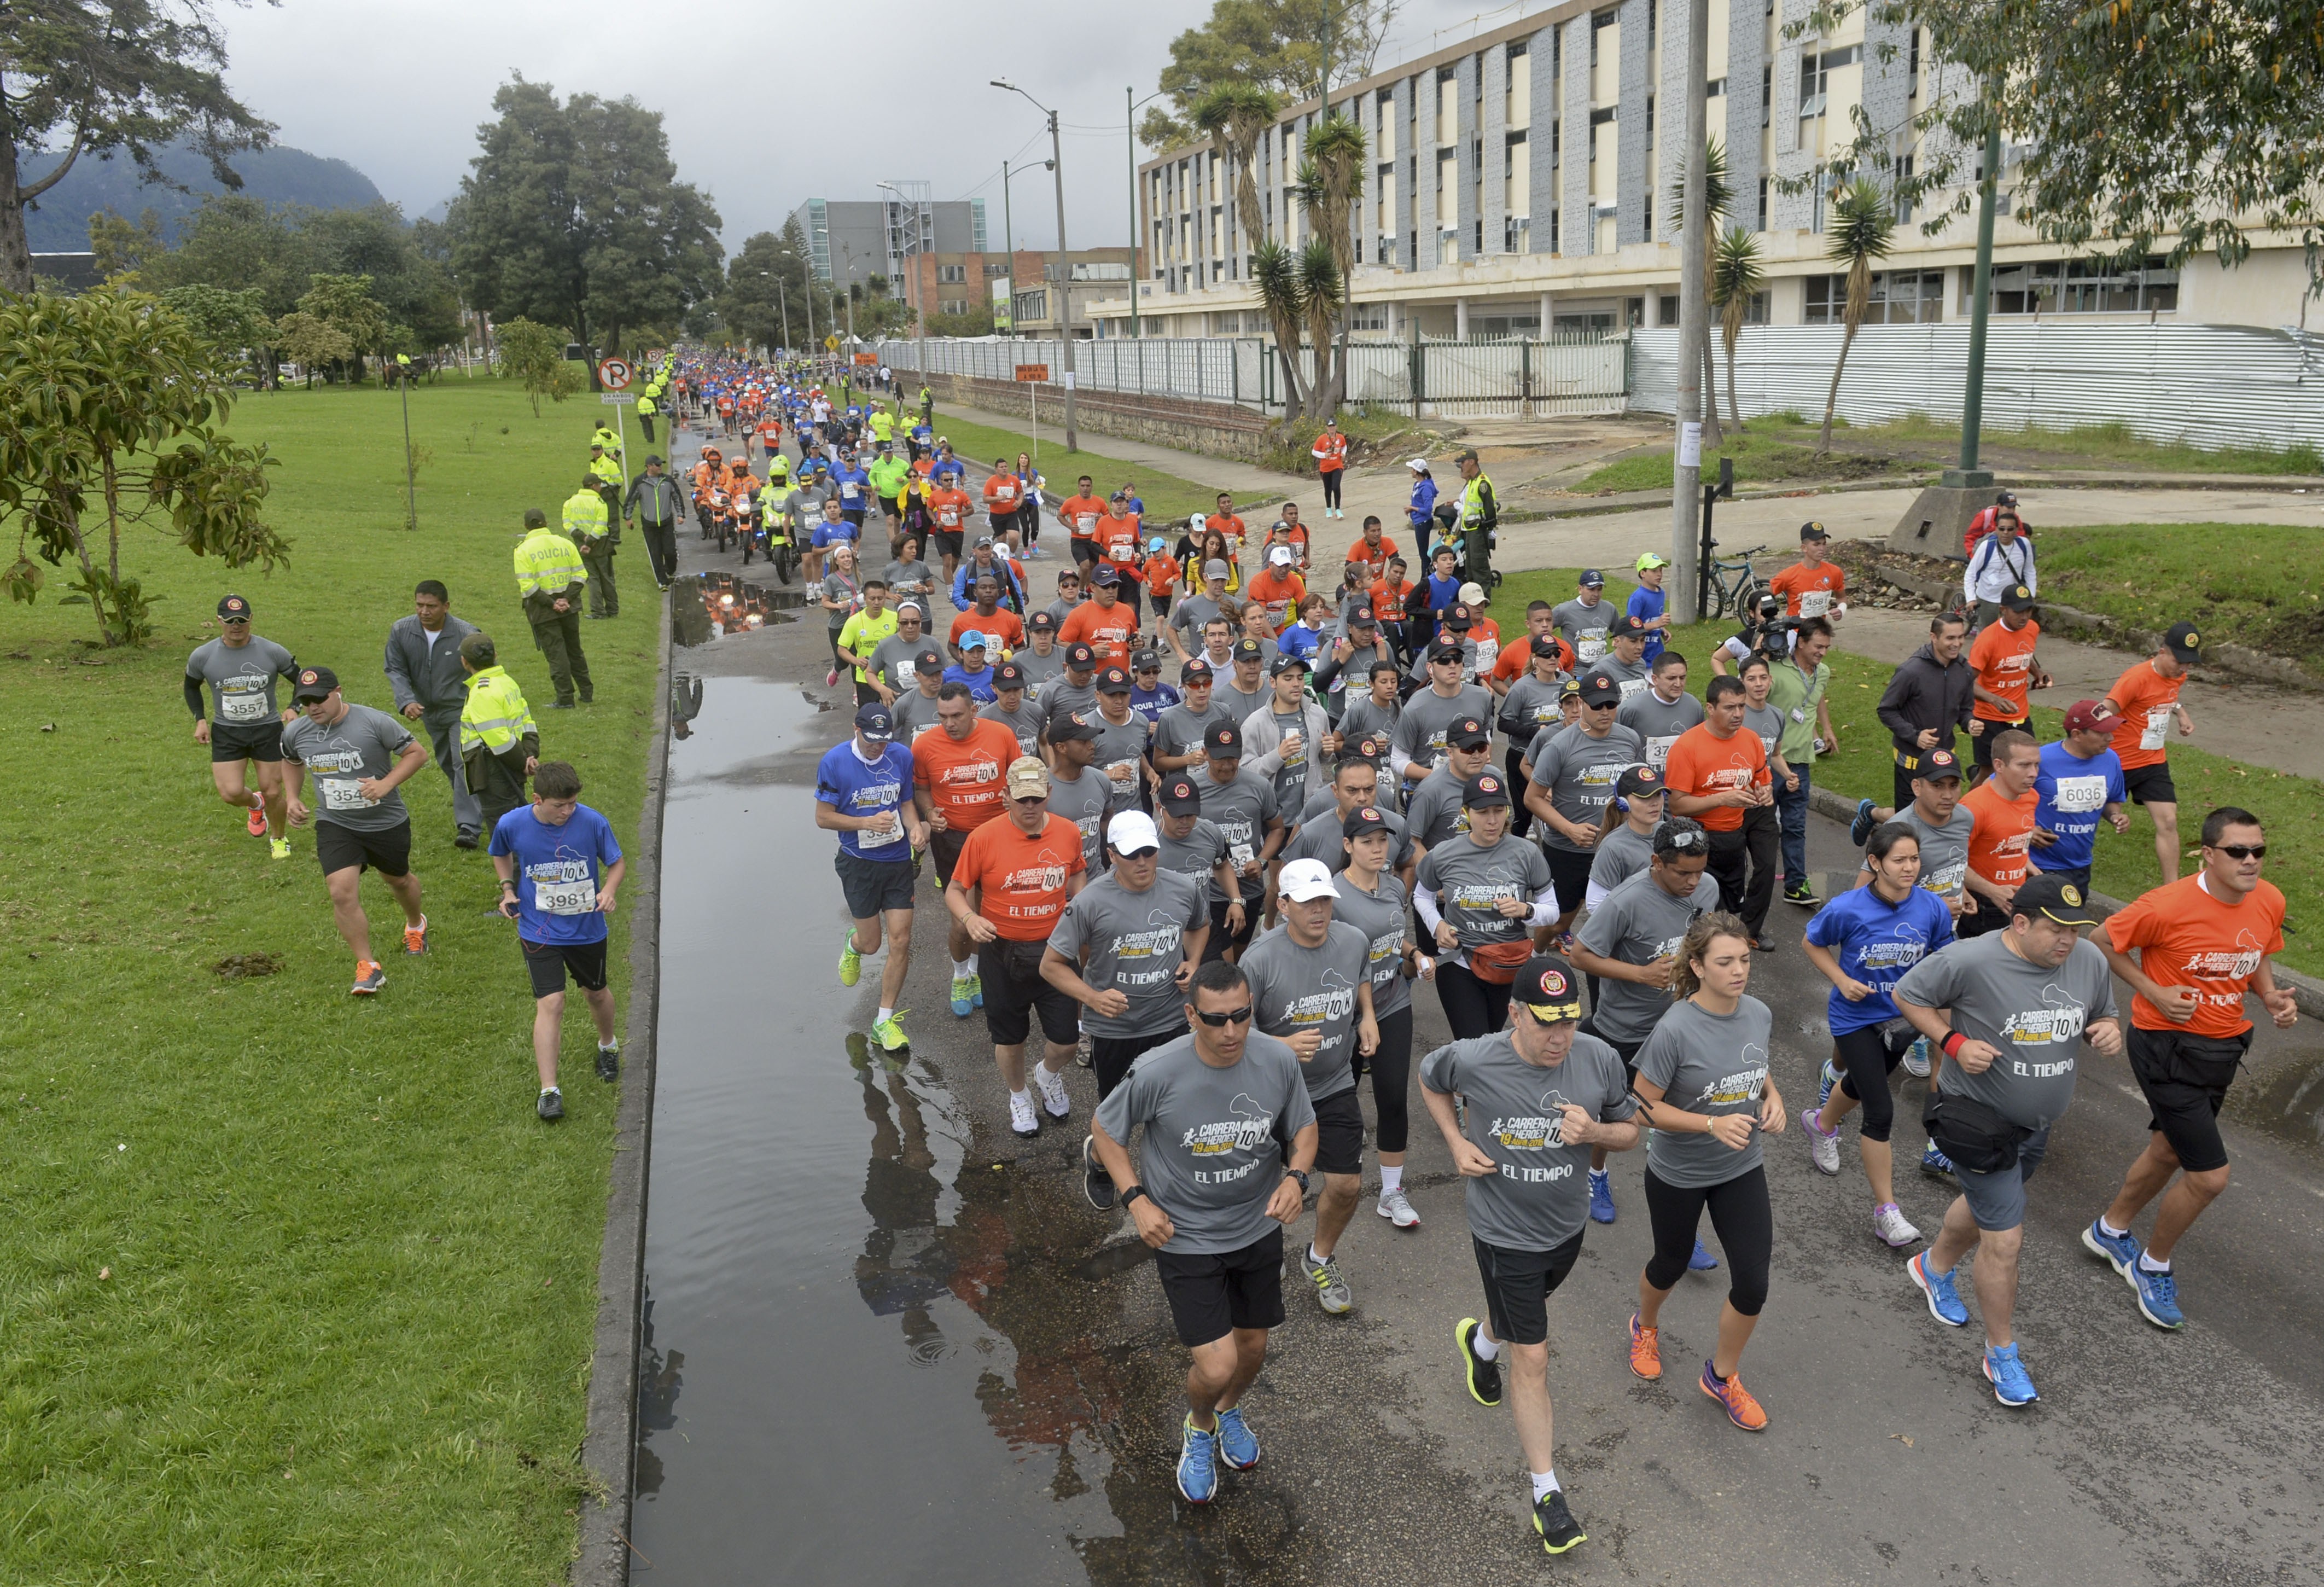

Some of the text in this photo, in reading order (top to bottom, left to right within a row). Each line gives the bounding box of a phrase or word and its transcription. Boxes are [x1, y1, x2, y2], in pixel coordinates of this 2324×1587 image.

[530, 548, 569, 563] POLICIA
[1806, 598, 1827, 606] 4581
[1477, 646, 1496, 656] 4625
[904, 667, 914, 676] 51
[224, 676, 249, 684] CARRERA
[249, 680, 258, 688] 10
[2007, 678, 2026, 687] TIEMPO
[230, 702, 263, 714] 3557
[1132, 702, 1154, 711] YOUR
[1155, 698, 1173, 708] MOVE
[1023, 743, 1031, 753] 10
[1653, 746, 1670, 757] 37
[312, 753, 339, 763] CARRERA
[340, 755, 359, 769] 10 K
[953, 764, 978, 774] CARRERA
[979, 766, 996, 780] 10 K
[1286, 777, 1294, 786] EL
[1377, 775, 1391, 786] 85
[1737, 775, 1745, 786] 10
[333, 789, 362, 801] 354
[860, 785, 883, 795] CARRERA
[882, 790, 892, 802] 10
[2066, 788, 2101, 801] 6036
[952, 792, 994, 804] EL TIEMPO
[1580, 795, 1591, 805] EL
[1090, 821, 1099, 832] 10
[2055, 823, 2095, 834] EL TIEMPO
[1232, 826, 1250, 840] 10 K
[534, 862, 562, 871] CARRERA
[564, 864, 585, 879] 10 K
[1016, 867, 1045, 879] CARRERA
[1045, 871, 1064, 887] 10 K
[1954, 870, 1963, 883] 10
[1995, 870, 2006, 881] EL
[1022, 876, 1042, 885] HEROES
[1464, 885, 1496, 896] CARRERA
[546, 892, 587, 908] 3981
[1460, 898, 1469, 908] 19
[1470, 894, 1493, 903] HEROES
[1009, 903, 1056, 916] EL TIEMPO
[1466, 917, 1514, 932] EL TIEMPO
[1125, 931, 1157, 943] CARRERA
[1156, 932, 1178, 950] 10 K
[1131, 940, 1154, 949] HEROES
[1871, 943, 1903, 954] CARRERA
[1119, 947, 1128, 956] 19
[1877, 952, 1899, 960] HEROES
[1900, 950, 1914, 963] 10
[2204, 952, 2241, 963] CARRERA
[1866, 958, 1874, 966] 19
[2209, 961, 2234, 972] HEROES
[2234, 960, 2250, 974] 10
[1117, 969, 1169, 985] EL TIEMPO
[1868, 981, 1895, 993] EL TIE
[1298, 992, 1330, 1009] CARRERA
[1330, 994, 1351, 1015] 10 K
[1304, 1003, 1327, 1015] HEROES
[1292, 1013, 1301, 1022] 19
[2020, 1010, 2055, 1024] CARRERA
[2027, 1022, 2052, 1033] HEROES
[2055, 1015, 2081, 1036] 10 K
[2013, 1029, 2025, 1041] 19
[2013, 1058, 2073, 1077] EL TIEMPO
[1720, 1070, 1755, 1089] CARRERA
[1725, 1083, 1751, 1095] HEROES
[1752, 1077, 1764, 1095] 10
[1199, 1121, 1241, 1137] CARRERA
[1507, 1117, 1551, 1130] CARRERA
[1207, 1133, 1237, 1146] HEROES
[1240, 1125, 1268, 1146] 10 K
[1500, 1133, 1512, 1145] 19
[1515, 1129, 1545, 1139] HEROES
[1192, 1142, 1204, 1153] 19
[1195, 1158, 1259, 1184] EL TIEMPO
[1502, 1164, 1573, 1182] EL TIEMPO
